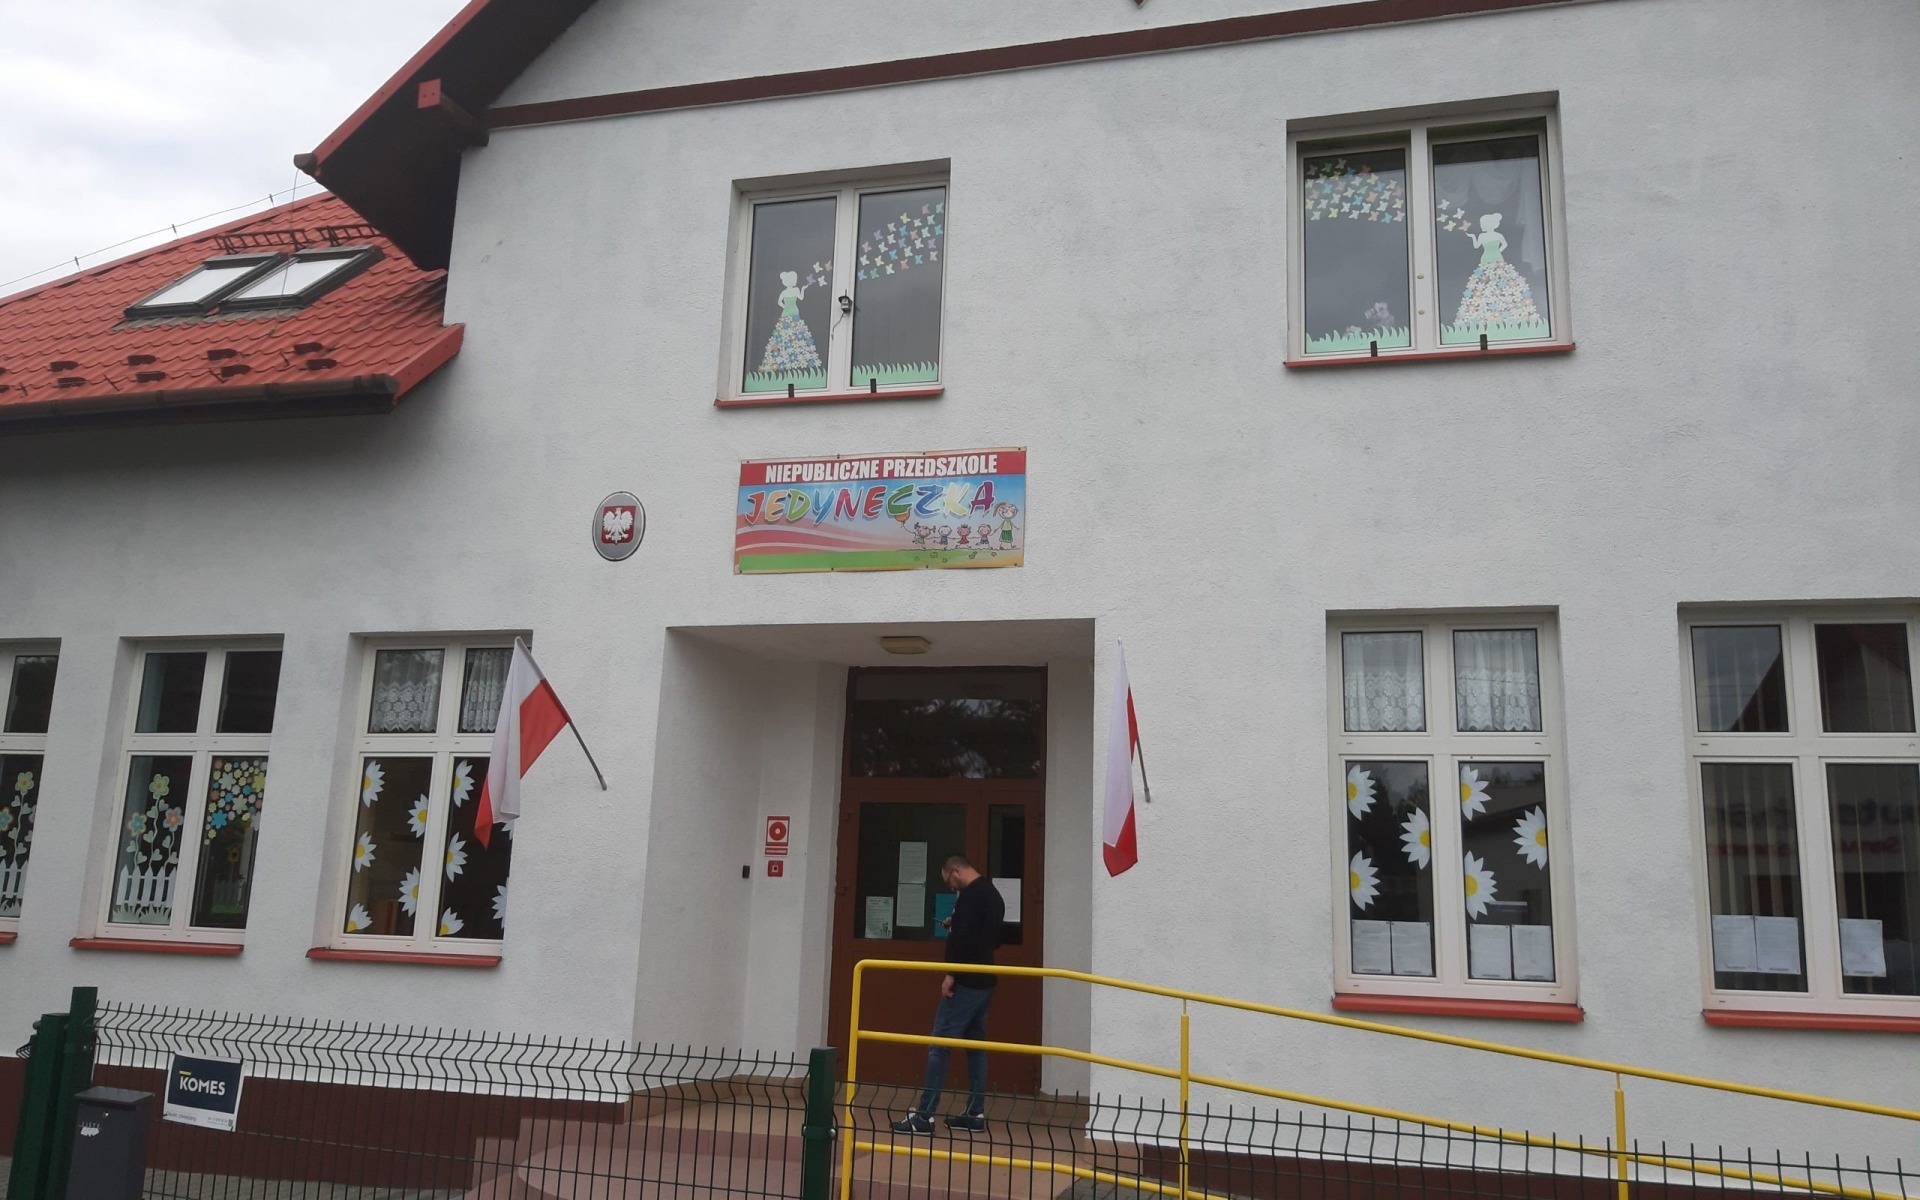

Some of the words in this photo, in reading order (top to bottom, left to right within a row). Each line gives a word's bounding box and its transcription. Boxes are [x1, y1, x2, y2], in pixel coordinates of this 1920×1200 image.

[765, 463, 879, 483] NIEPUBLICZNE
[883, 455, 997, 477] PRZEDSZKOLE
[745, 480, 996, 525] JEDYNECZKA
[179, 1077, 226, 1096] KOMES
